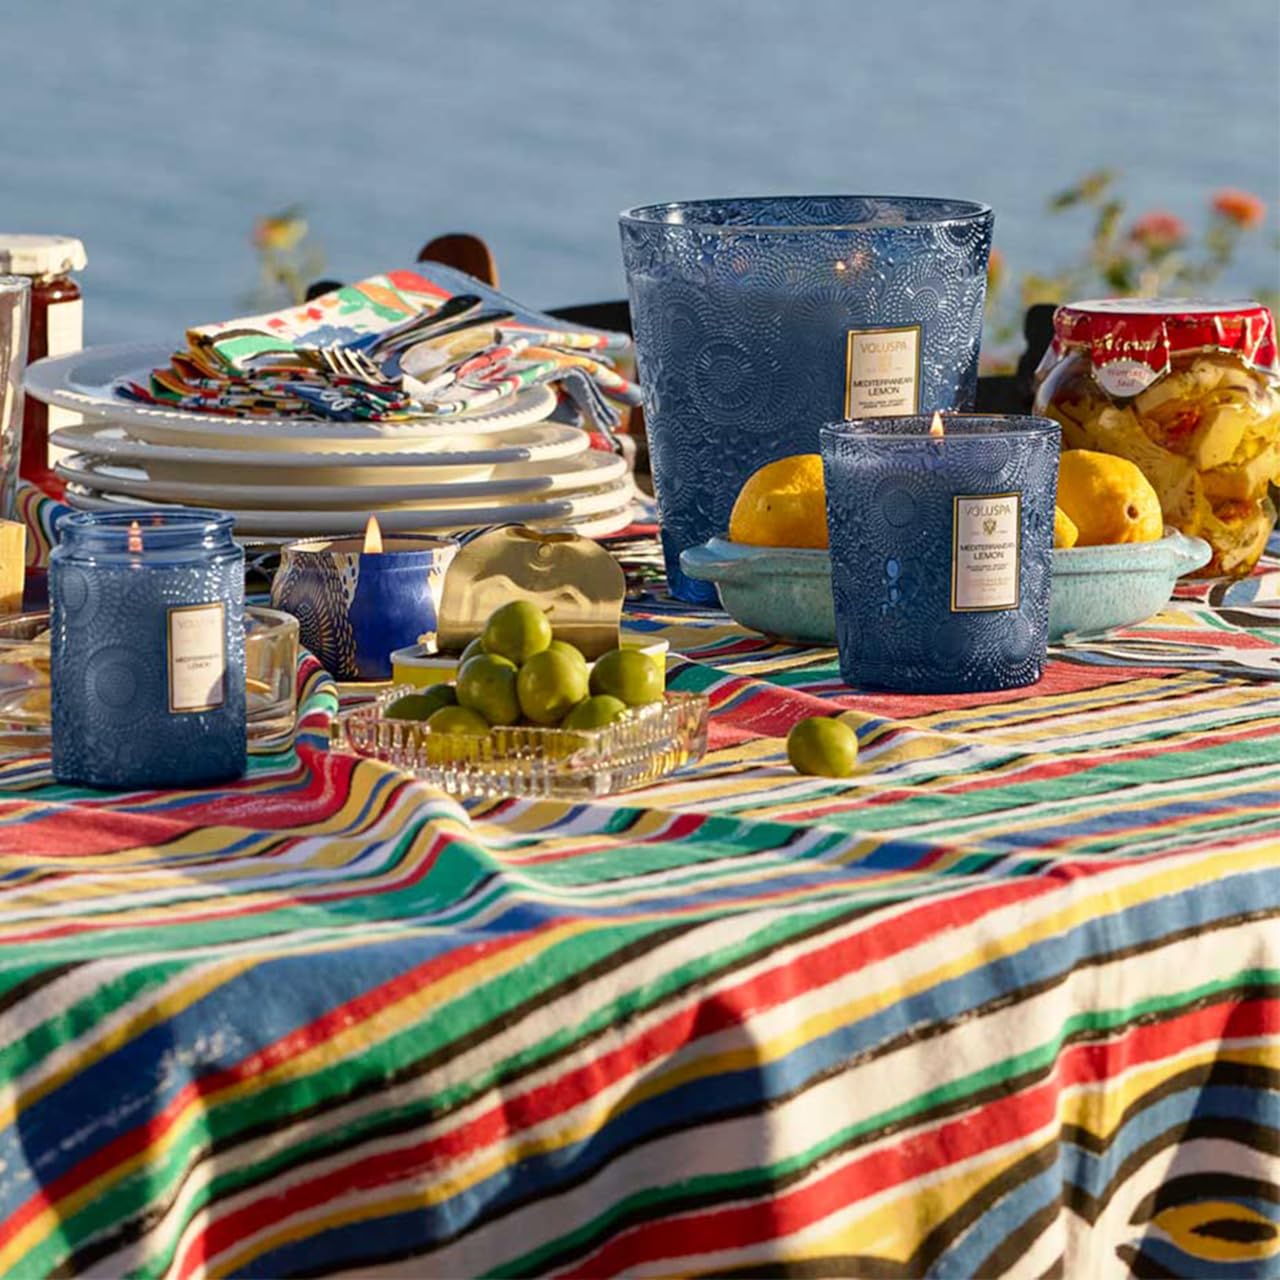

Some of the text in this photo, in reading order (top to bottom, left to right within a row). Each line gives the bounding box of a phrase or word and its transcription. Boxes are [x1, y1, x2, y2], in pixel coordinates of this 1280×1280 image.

[860, 340, 908, 354] VOLUSPA
[868, 386, 900, 397] LEMON
[965, 504, 1011, 517] VOLUSPA
[973, 551, 1005, 561] LEMON
